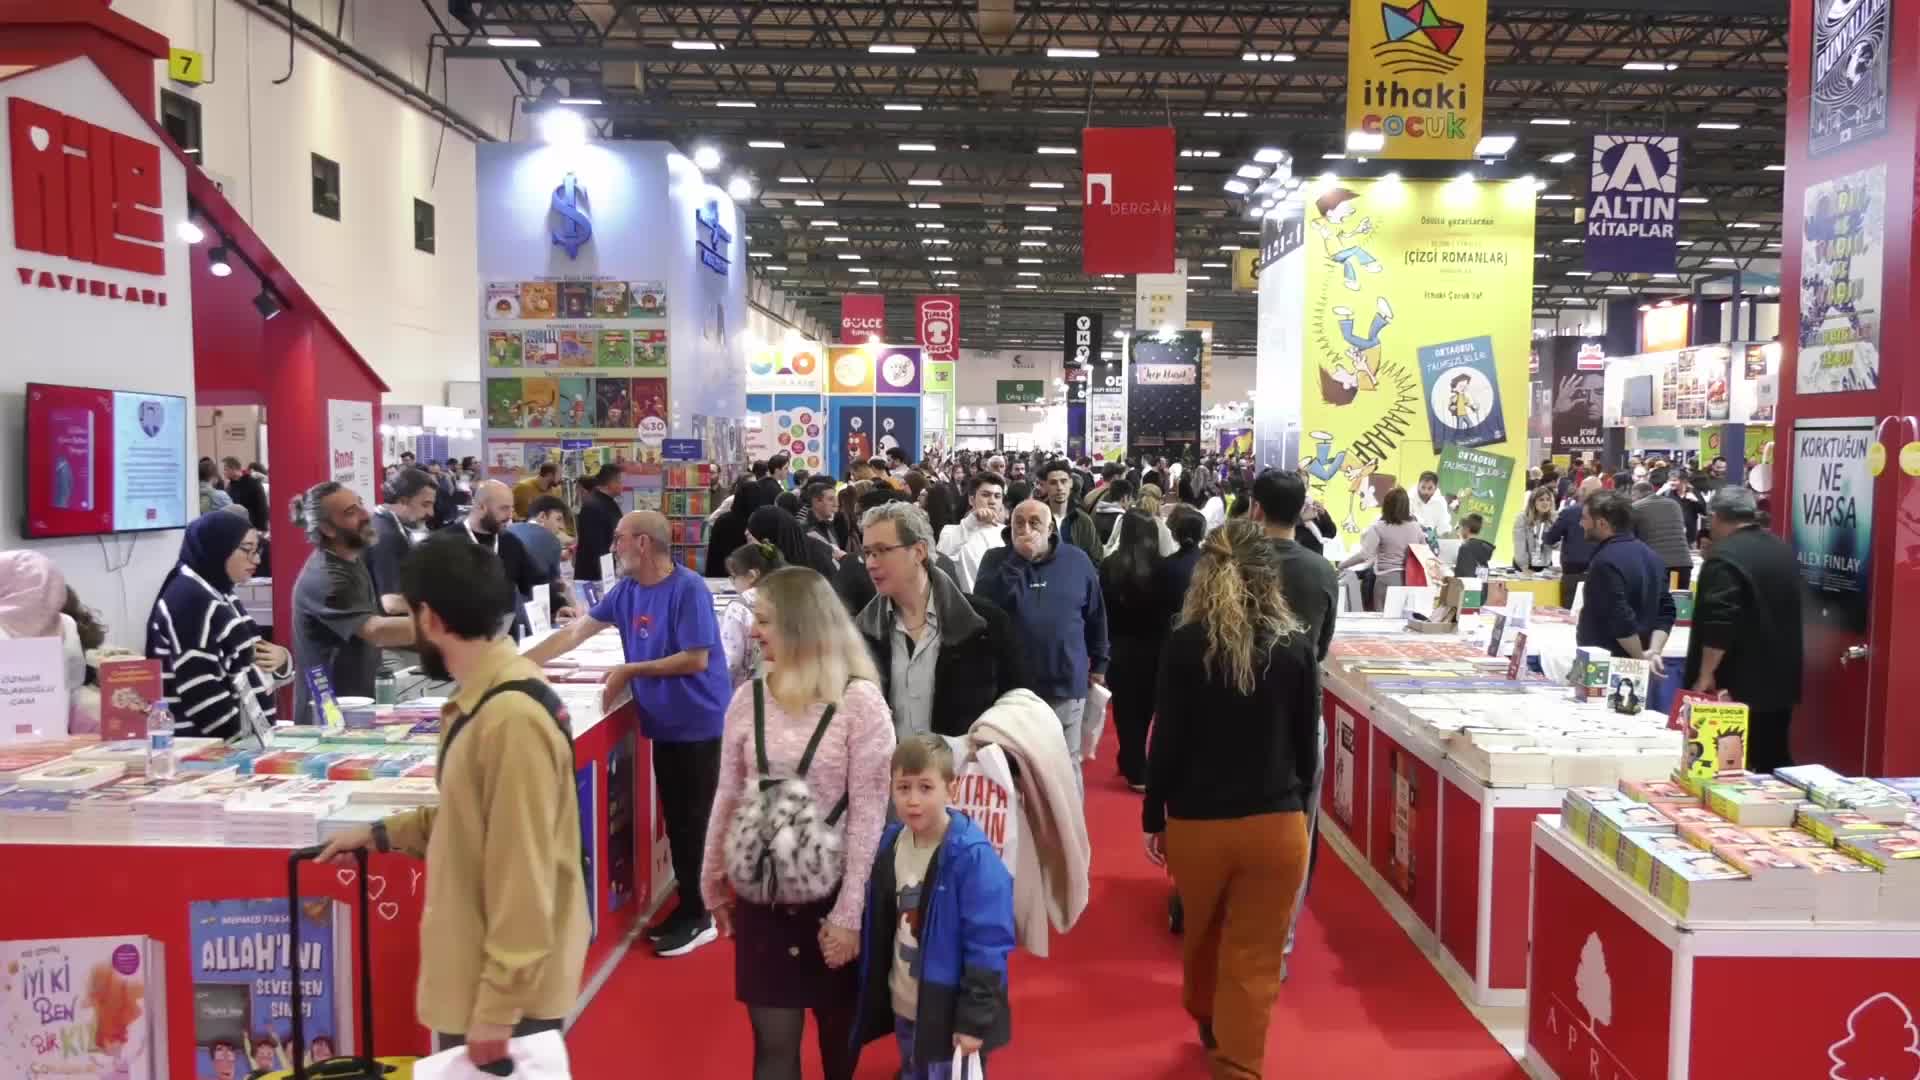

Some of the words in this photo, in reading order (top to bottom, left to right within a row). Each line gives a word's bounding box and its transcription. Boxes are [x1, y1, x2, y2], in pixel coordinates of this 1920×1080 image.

[180, 56, 192, 74] 7
[1363, 79, 1466, 109] ithaki
[1589, 196, 1675, 221] ALTIN
[1588, 219, 1674, 239] KİTAPLAR
[640, 420, 665, 433] %30
[1800, 436, 1868, 459] KORKTUĞUN
[1818, 463, 1844, 492] NE
[1803, 493, 1857, 529] VARSA
[1823, 553, 1861, 573] FINLAY
[33, 995, 78, 1025] BEN
